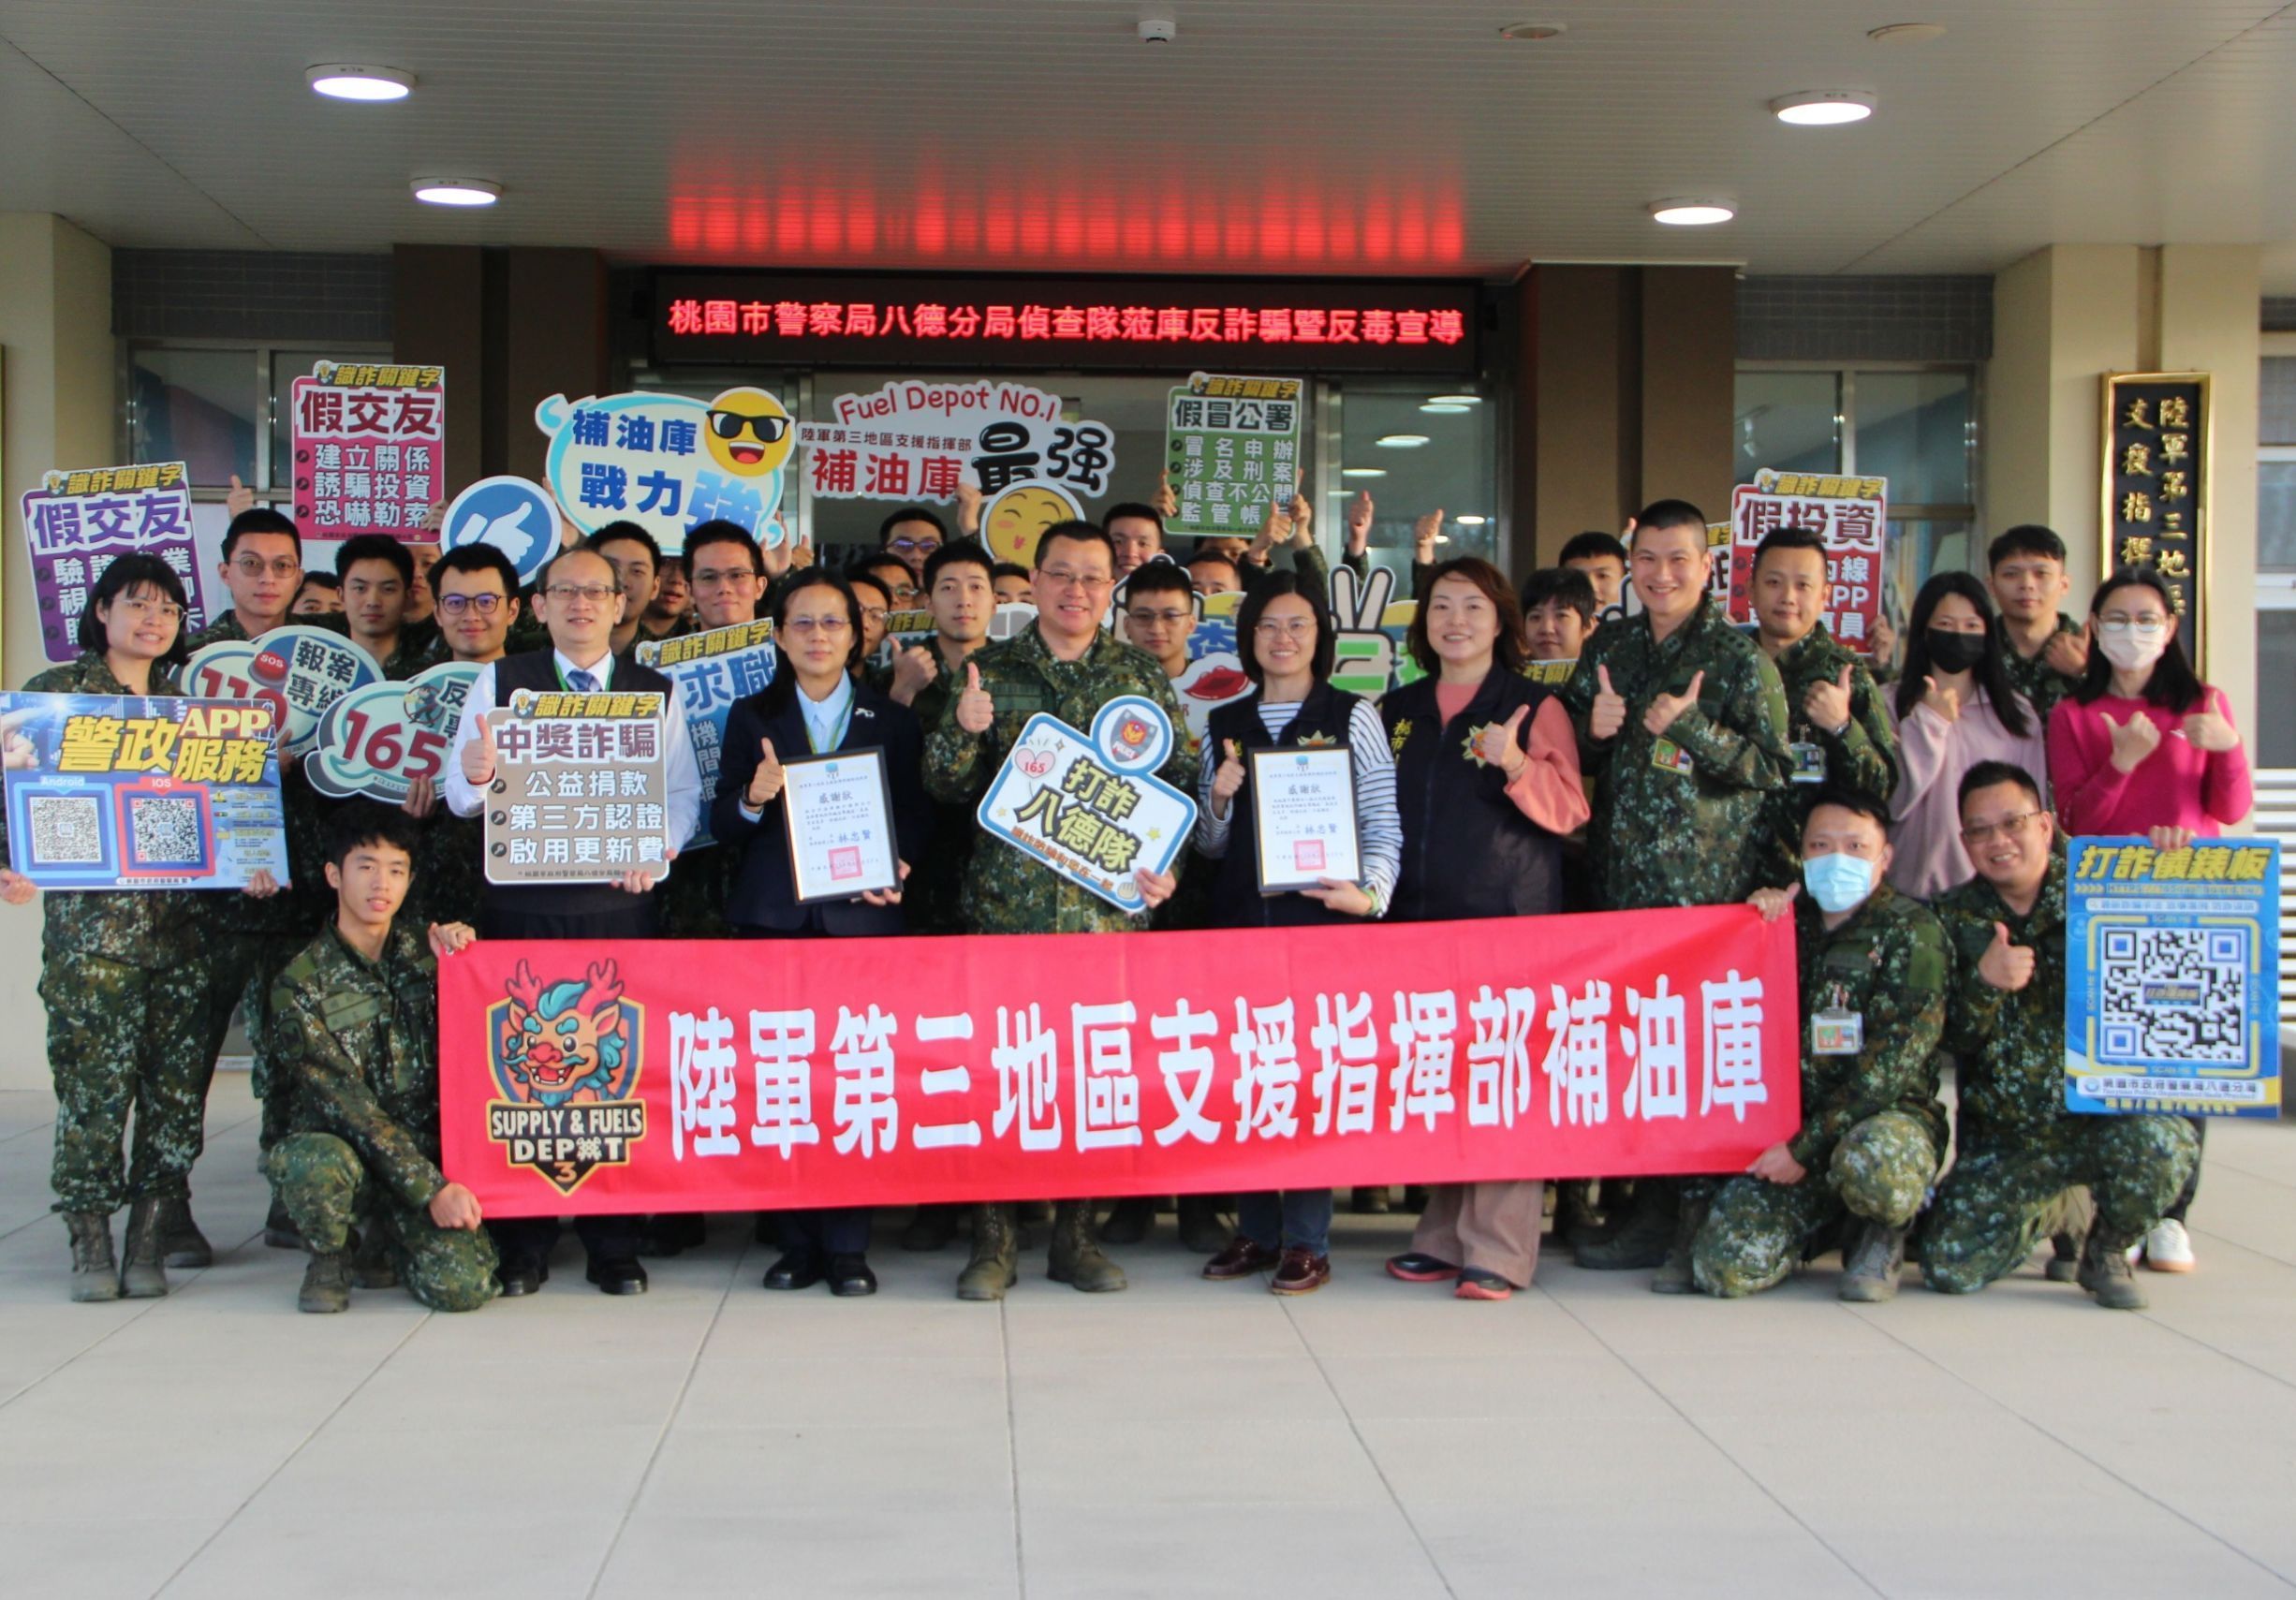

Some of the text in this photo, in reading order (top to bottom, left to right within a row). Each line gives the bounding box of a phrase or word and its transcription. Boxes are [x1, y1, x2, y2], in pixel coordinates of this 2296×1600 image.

[334, 365, 441, 387] 識詐關鍵字
[302, 391, 435, 435] 假交友
[839, 389, 897, 425] Fuel
[905, 386, 990, 417] Depot
[1176, 400, 1292, 431] 假冒公署
[572, 408, 697, 456] 補油庫
[801, 427, 972, 451] 陸軍第三地區支援指揮部
[315, 444, 431, 472] 建立關係
[1184, 458, 1292, 482] 涉及刑案
[66, 464, 183, 494] 識詐關鍵字
[315, 472, 431, 500] 誘騙投資
[812, 448, 963, 499] 補油庫
[1183, 479, 1293, 504] 偵查不公開
[35, 494, 186, 547] 假交友
[315, 500, 429, 528] 恐嚇勒索
[1182, 502, 1289, 524] 監管帳
[1741, 499, 1875, 545] 假投資
[660, 622, 771, 666] 識詐關鍵字
[260, 653, 284, 668] SOS
[295, 640, 356, 683] 報案
[667, 650, 774, 710] 求職
[535, 694, 661, 717] 識詐關鍵字
[180, 708, 271, 738] APP
[58, 715, 182, 772] 警政
[343, 709, 448, 780] 165
[496, 723, 655, 759] 中獎詐騙
[172, 738, 271, 783] 服務
[1023, 761, 1045, 773] 165
[40, 776, 85, 786] Android
[525, 771, 648, 797] 公益捐款
[1062, 756, 1140, 820] 打詐
[509, 803, 663, 830] 第三方認證
[1016, 785, 1141, 873] 八德隊
[509, 836, 664, 864] 啟用更新費
[668, 968, 1768, 1161] 陸軍第三地區支援指揮部補油庫
[493, 1108, 642, 1136] SUPPLY & FUELS
[554, 1161, 577, 1182] 3
